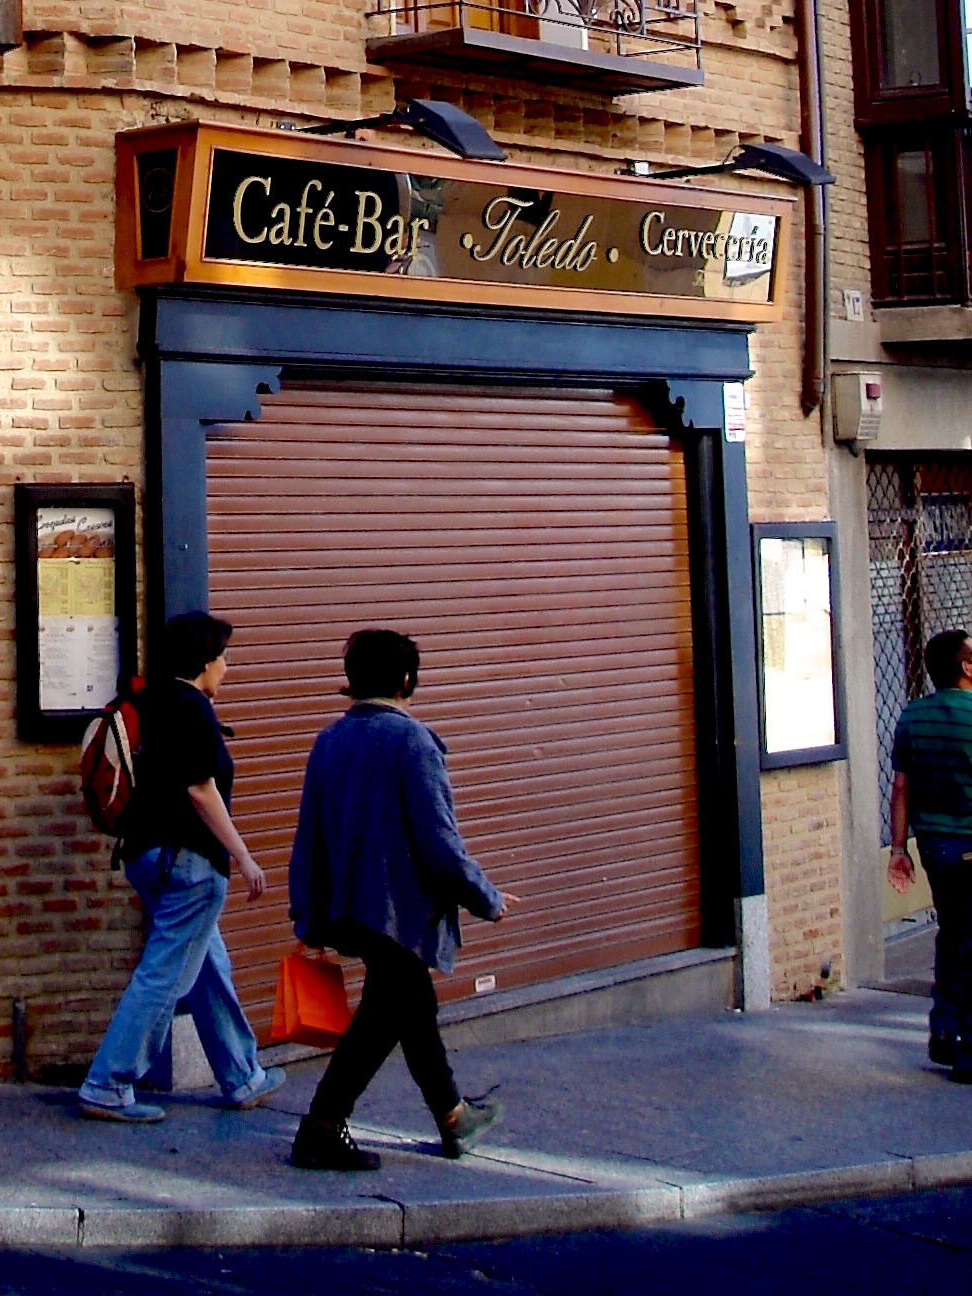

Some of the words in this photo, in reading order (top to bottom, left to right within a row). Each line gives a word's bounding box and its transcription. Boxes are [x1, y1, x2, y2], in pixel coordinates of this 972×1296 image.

[232, 175, 429, 257] Café-Bar
[473, 194, 599, 272] Toledo
[639, 209, 771, 265] Cervecería
